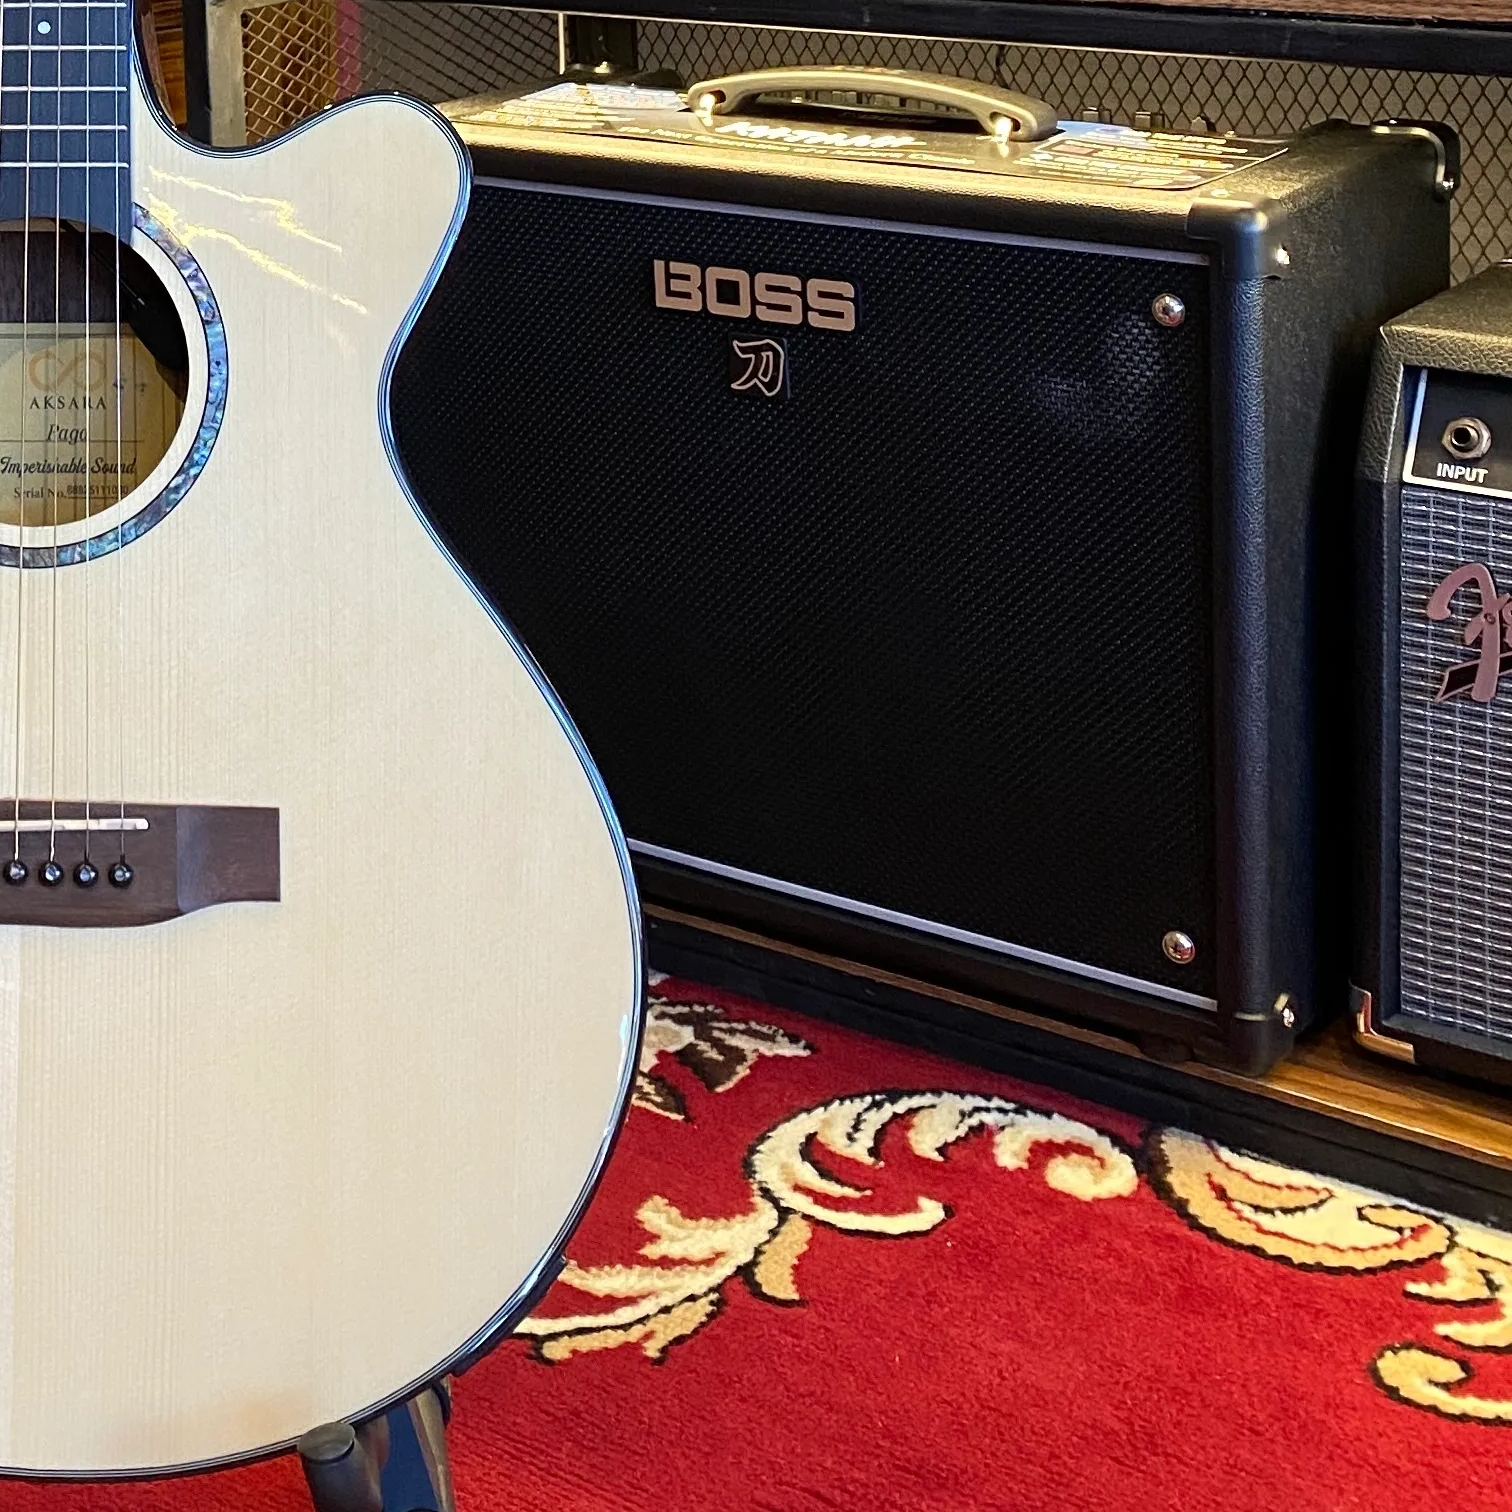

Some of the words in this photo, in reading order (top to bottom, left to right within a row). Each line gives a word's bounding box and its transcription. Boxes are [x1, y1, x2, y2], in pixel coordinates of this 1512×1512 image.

[654, 259, 856, 332] BOSS
[29, 395, 107, 410] AKSARA
[0, 455, 87, 478] Imperishable
[91, 455, 137, 474] Sound
[1436, 462, 1489, 484] INPUT
